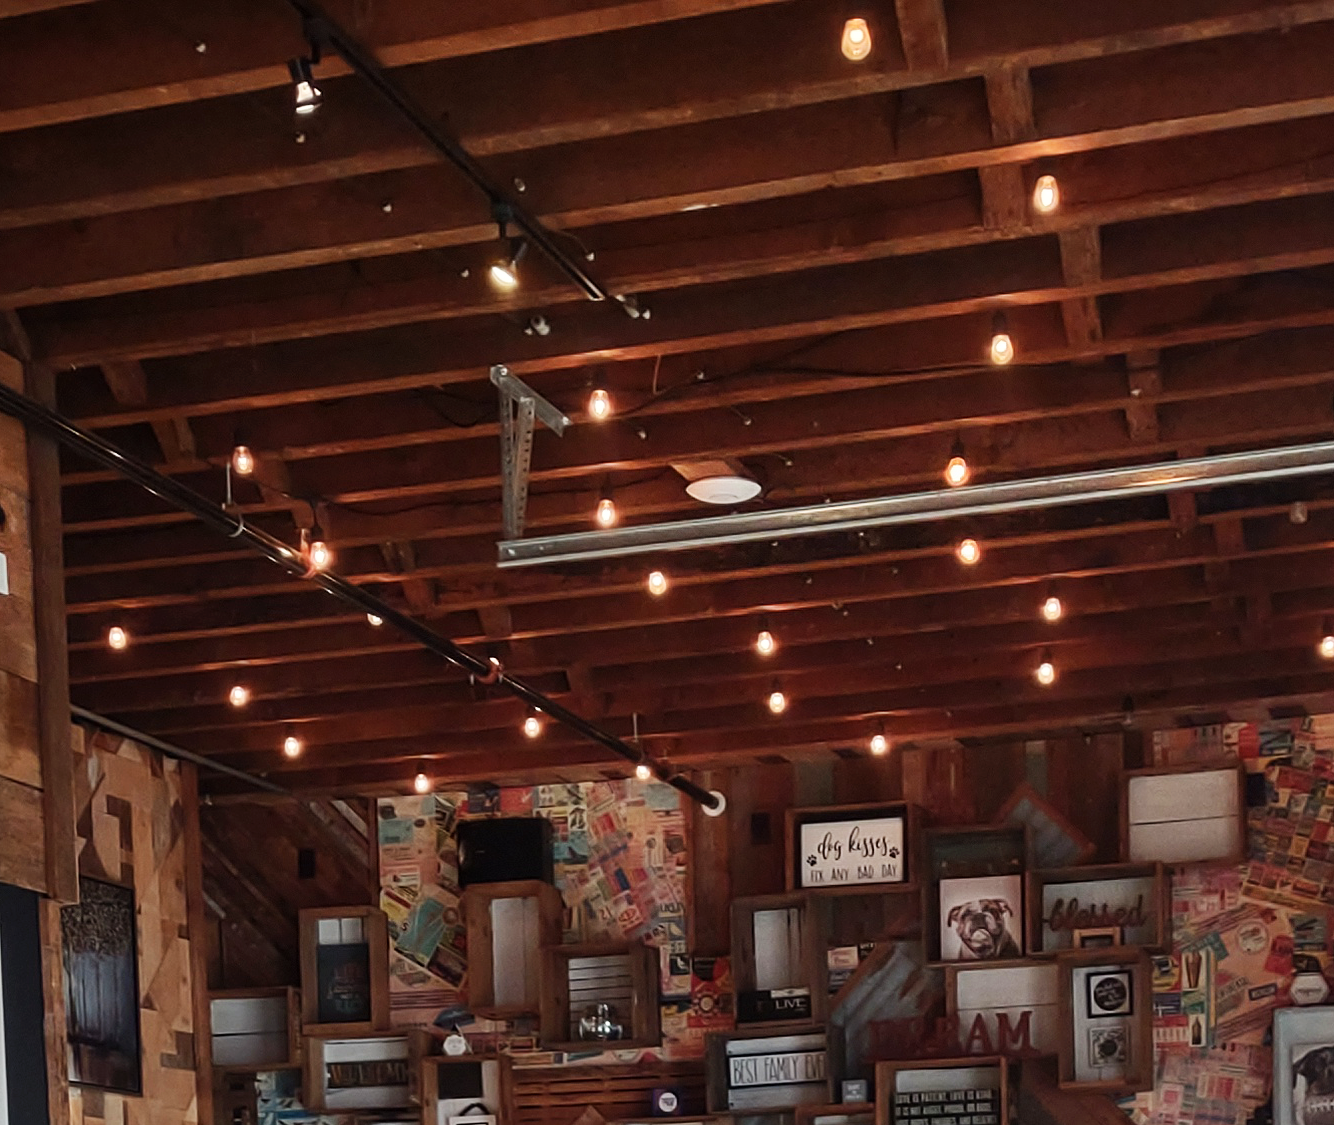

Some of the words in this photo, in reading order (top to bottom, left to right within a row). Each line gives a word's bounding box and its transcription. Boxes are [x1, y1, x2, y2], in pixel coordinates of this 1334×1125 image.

[818, 832, 841, 860] dog
[849, 826, 887, 857] kisses
[882, 864, 897, 877] DAY
[733, 1058, 757, 1084] BEST
[765, 1055, 798, 1081] FAMILY
